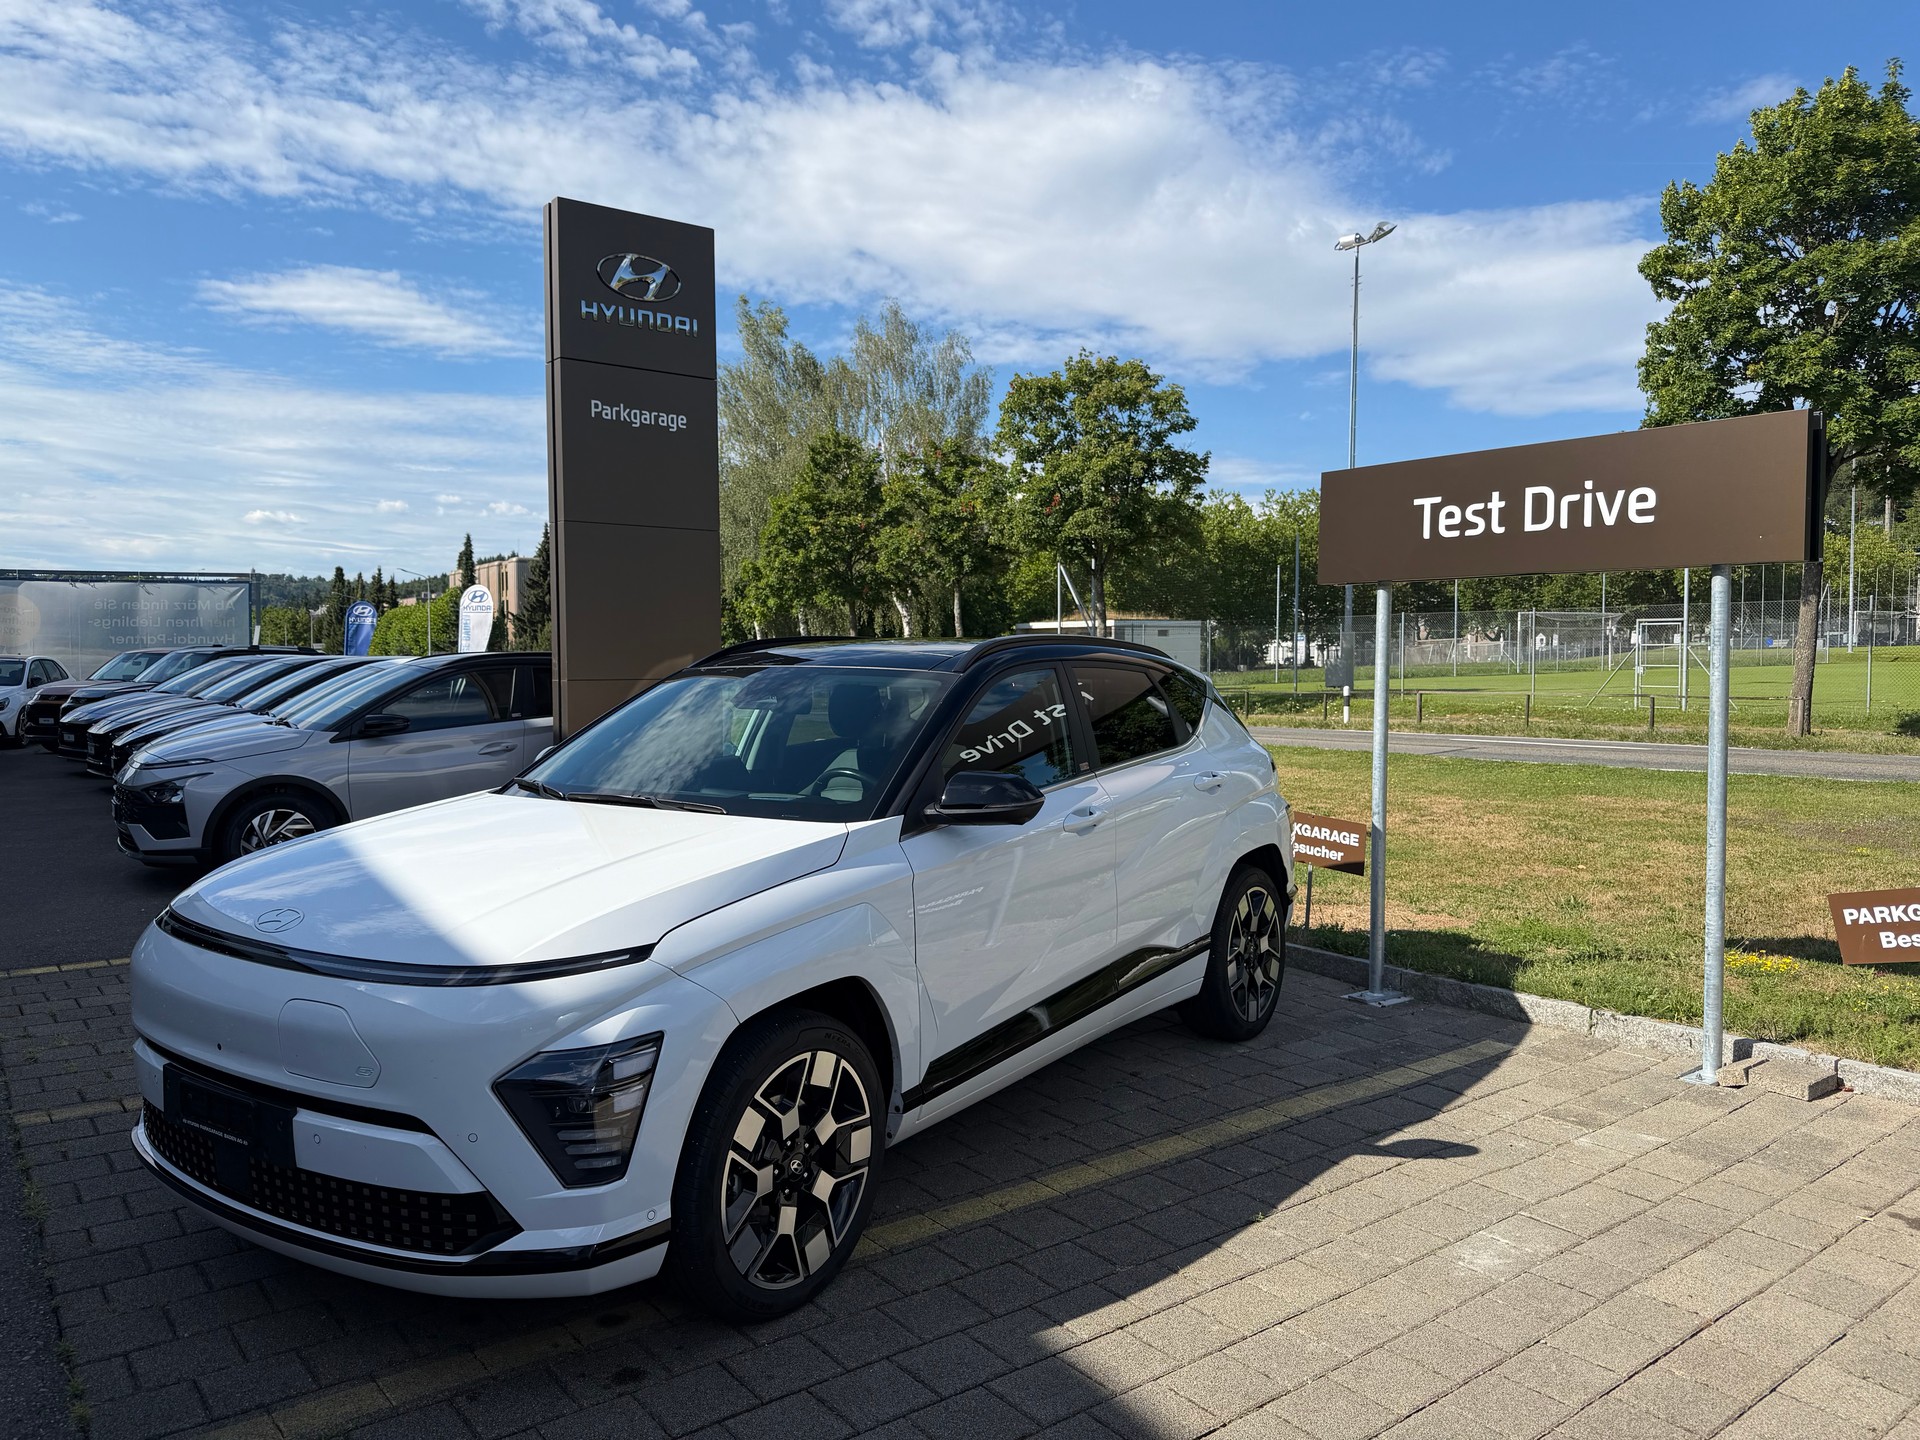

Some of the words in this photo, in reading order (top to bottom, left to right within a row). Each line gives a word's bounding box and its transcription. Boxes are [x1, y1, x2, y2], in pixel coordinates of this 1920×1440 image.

[580, 300, 698, 338] HYUNDAI
[590, 399, 687, 432] Parkgarage
[1413, 491, 1506, 540] Test
[1524, 480, 1656, 532] Drive
[1293, 822, 1360, 847] KGARAGE
[1293, 842, 1345, 861] esucher
